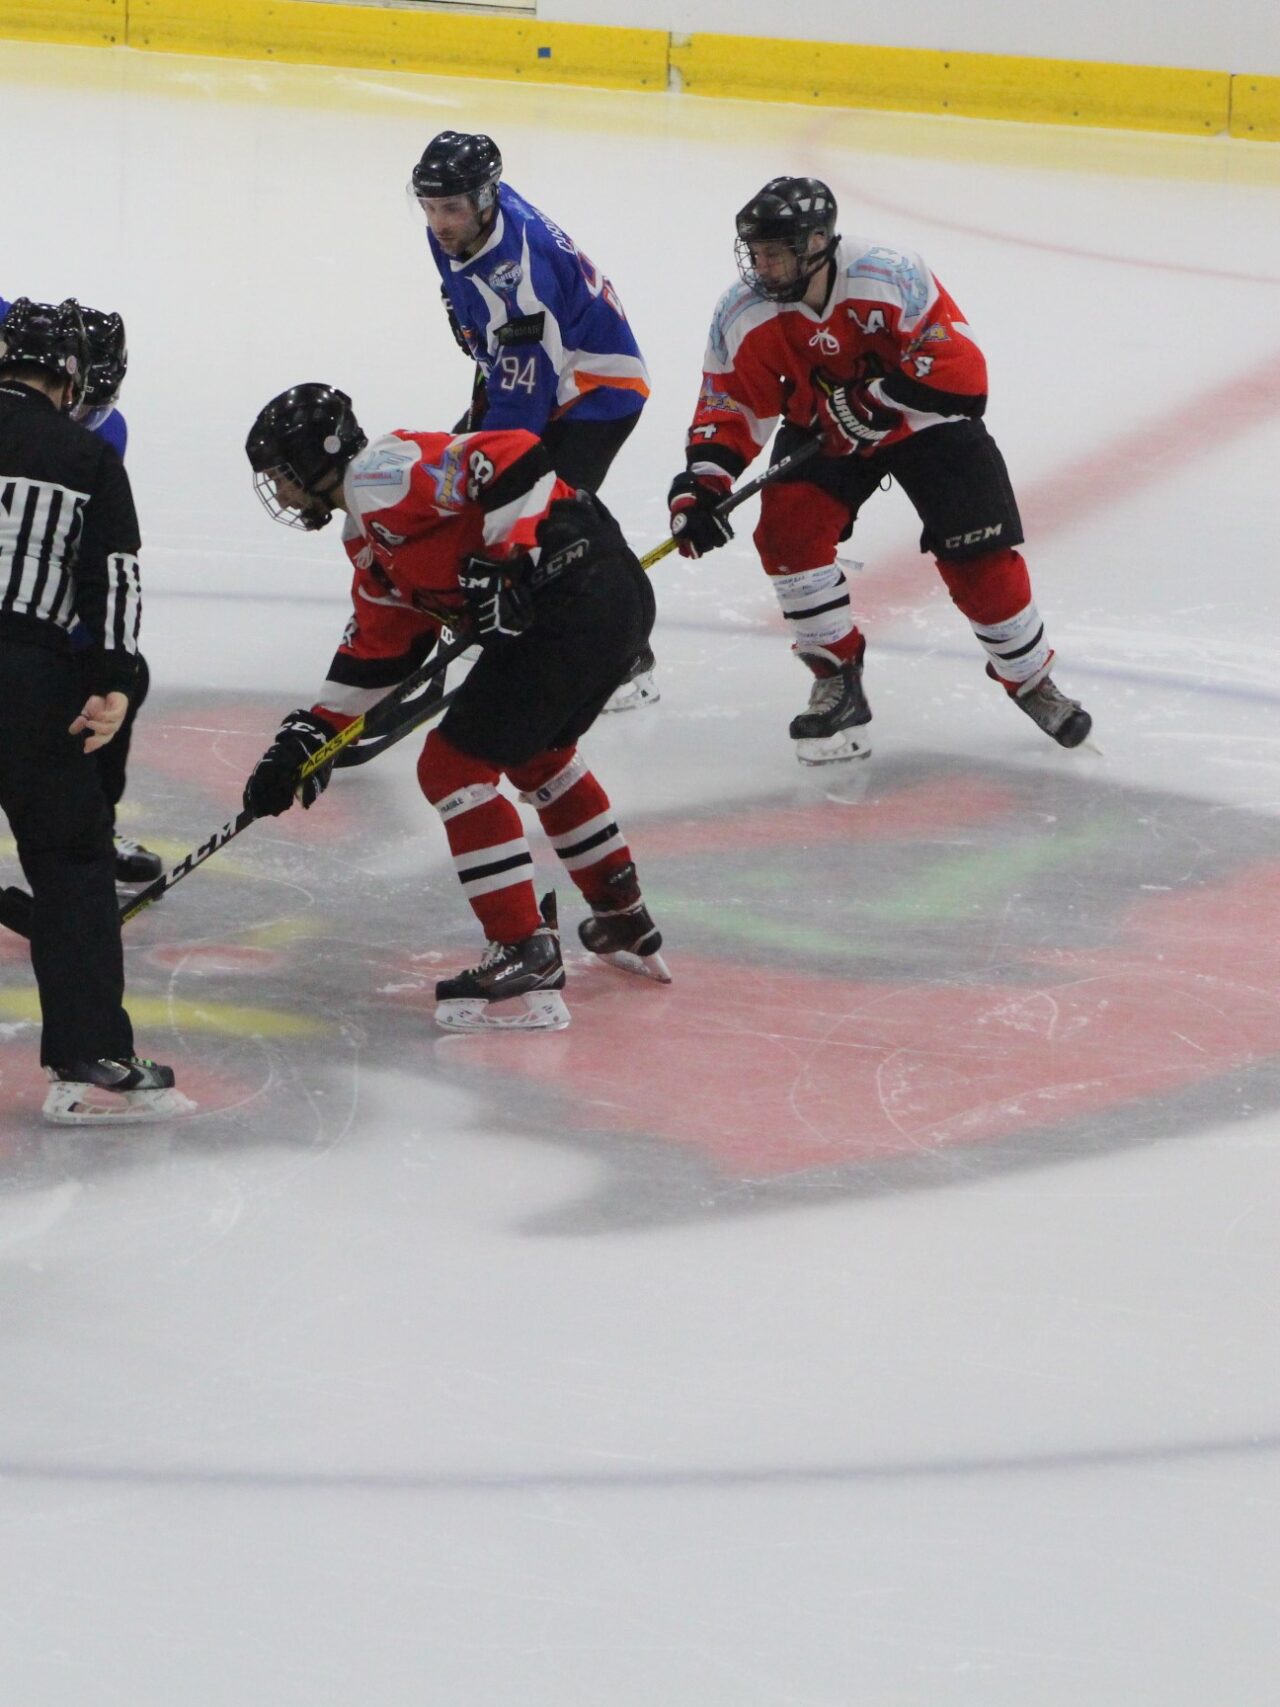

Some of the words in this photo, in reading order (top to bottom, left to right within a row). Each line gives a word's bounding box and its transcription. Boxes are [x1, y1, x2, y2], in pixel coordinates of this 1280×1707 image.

[500, 356, 536, 394] 94
[945, 523, 1002, 549] CCM
[458, 574, 490, 588] CM
[303, 735, 345, 771] ACKS
[165, 821, 237, 886] CCM
[494, 961, 524, 981] CCM
